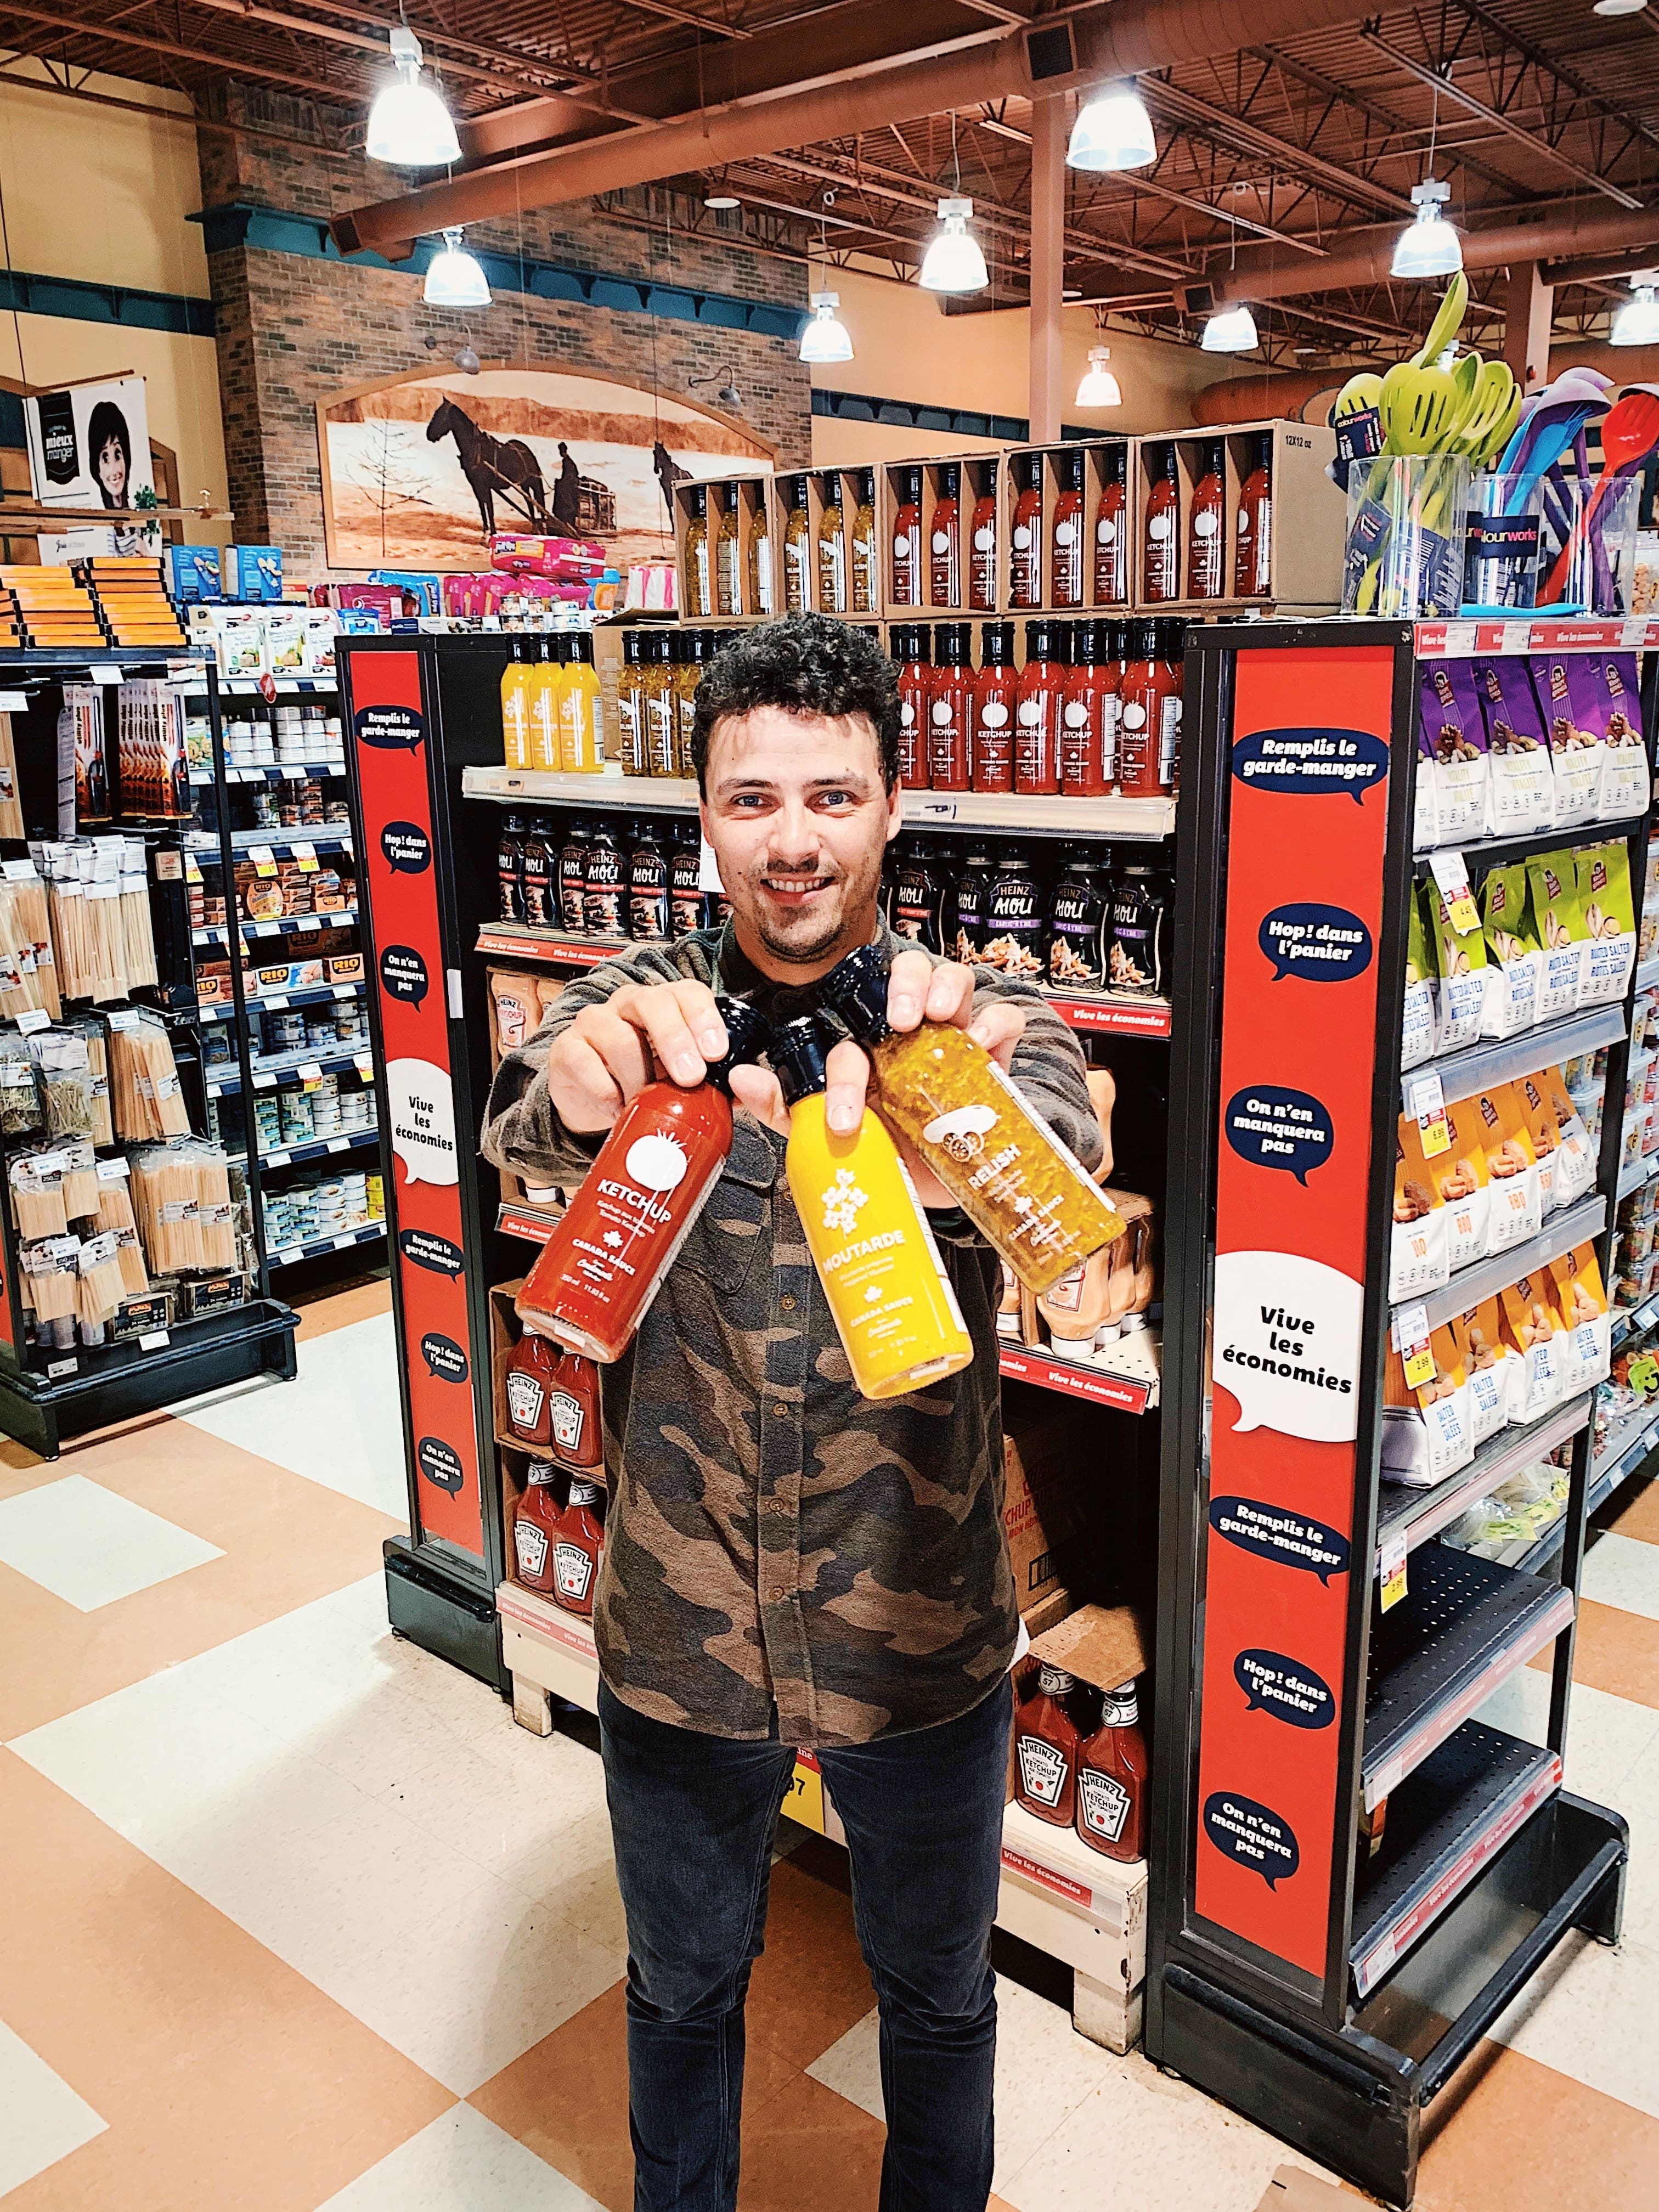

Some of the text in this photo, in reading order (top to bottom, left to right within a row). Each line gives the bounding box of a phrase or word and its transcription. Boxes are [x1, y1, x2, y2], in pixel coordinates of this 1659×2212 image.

[46, 432, 73, 449] mieux
[1481, 528, 1537, 543] lourworks
[368, 713, 410, 726] Remplis le
[362, 726, 420, 739] garde-manger
[1262, 738, 1357, 758] Remplis le
[1243, 758, 1376, 779] garde-manger
[385, 834, 426, 849] Hop! dans
[564, 861, 582, 876] AIOL
[591, 855, 615, 864] HEINZ
[1000, 885, 1030, 895] HEINZ
[1269, 921, 1363, 944] Hop! dans
[334, 959, 359, 969] RIO
[388, 955, 399, 965] On
[578, 952, 610, 961] économi
[261, 969, 287, 980] RIO
[384, 967, 425, 984] manquera
[398, 981, 413, 991] pas
[1073, 1009, 1165, 1026] Vive les économies
[408, 1095, 435, 1114] Vive
[1246, 1099, 1272, 1115] On
[414, 1113, 430, 1129] les
[1233, 1115, 1325, 1142] manquera
[395, 1124, 453, 1151] économies
[1261, 1138, 1295, 1155] pas
[967, 1143, 1022, 1191] RELISH
[597, 1179, 672, 1223] KETCHUP
[507, 1221, 521, 1231] Vive
[529, 1226, 551, 1237] économ
[412, 1234, 451, 1255] Remplis le
[572, 1239, 608, 1260] CANADA
[822, 1229, 906, 1275] MOUTARDE
[405, 1244, 461, 1271] garde-manger
[1260, 1306, 1315, 1335] Vive
[425, 1340, 465, 1364] Hop! dans
[1269, 1332, 1304, 1356] les
[1223, 1344, 1352, 1394] économies
[515, 1378, 532, 1390] HEINZ
[1048, 1372, 1133, 1402] Vive les économies
[1472, 1376, 1494, 1393] SALTED
[557, 1398, 572, 1409] HEINZ
[425, 1444, 436, 1457] On
[421, 1454, 461, 1477] manquera
[435, 1466, 449, 1482] pas
[1005, 1501, 1032, 1526] CHUP
[1237, 1504, 1323, 1544] Remplis le
[522, 1528, 538, 1539] HEINZ
[1219, 1516, 1341, 1566] garde-manger
[562, 1549, 582, 1561] HEINZ
[560, 1562, 584, 1575] KETCHUP
[1243, 1658, 1328, 1702] Hop! dans
[1028, 1744, 1054, 1761] HEINZ
[1026, 1758, 1057, 1776] KETCHUP
[1090, 1776, 1115, 1795] HEINZ
[1086, 1791, 1119, 1810] KETCHUP
[1222, 1802, 1245, 1820] On
[1211, 1812, 1292, 1859] manquera
[1235, 1839, 1265, 1860] pas
[1003, 1850, 1081, 1895] Vive les économies
